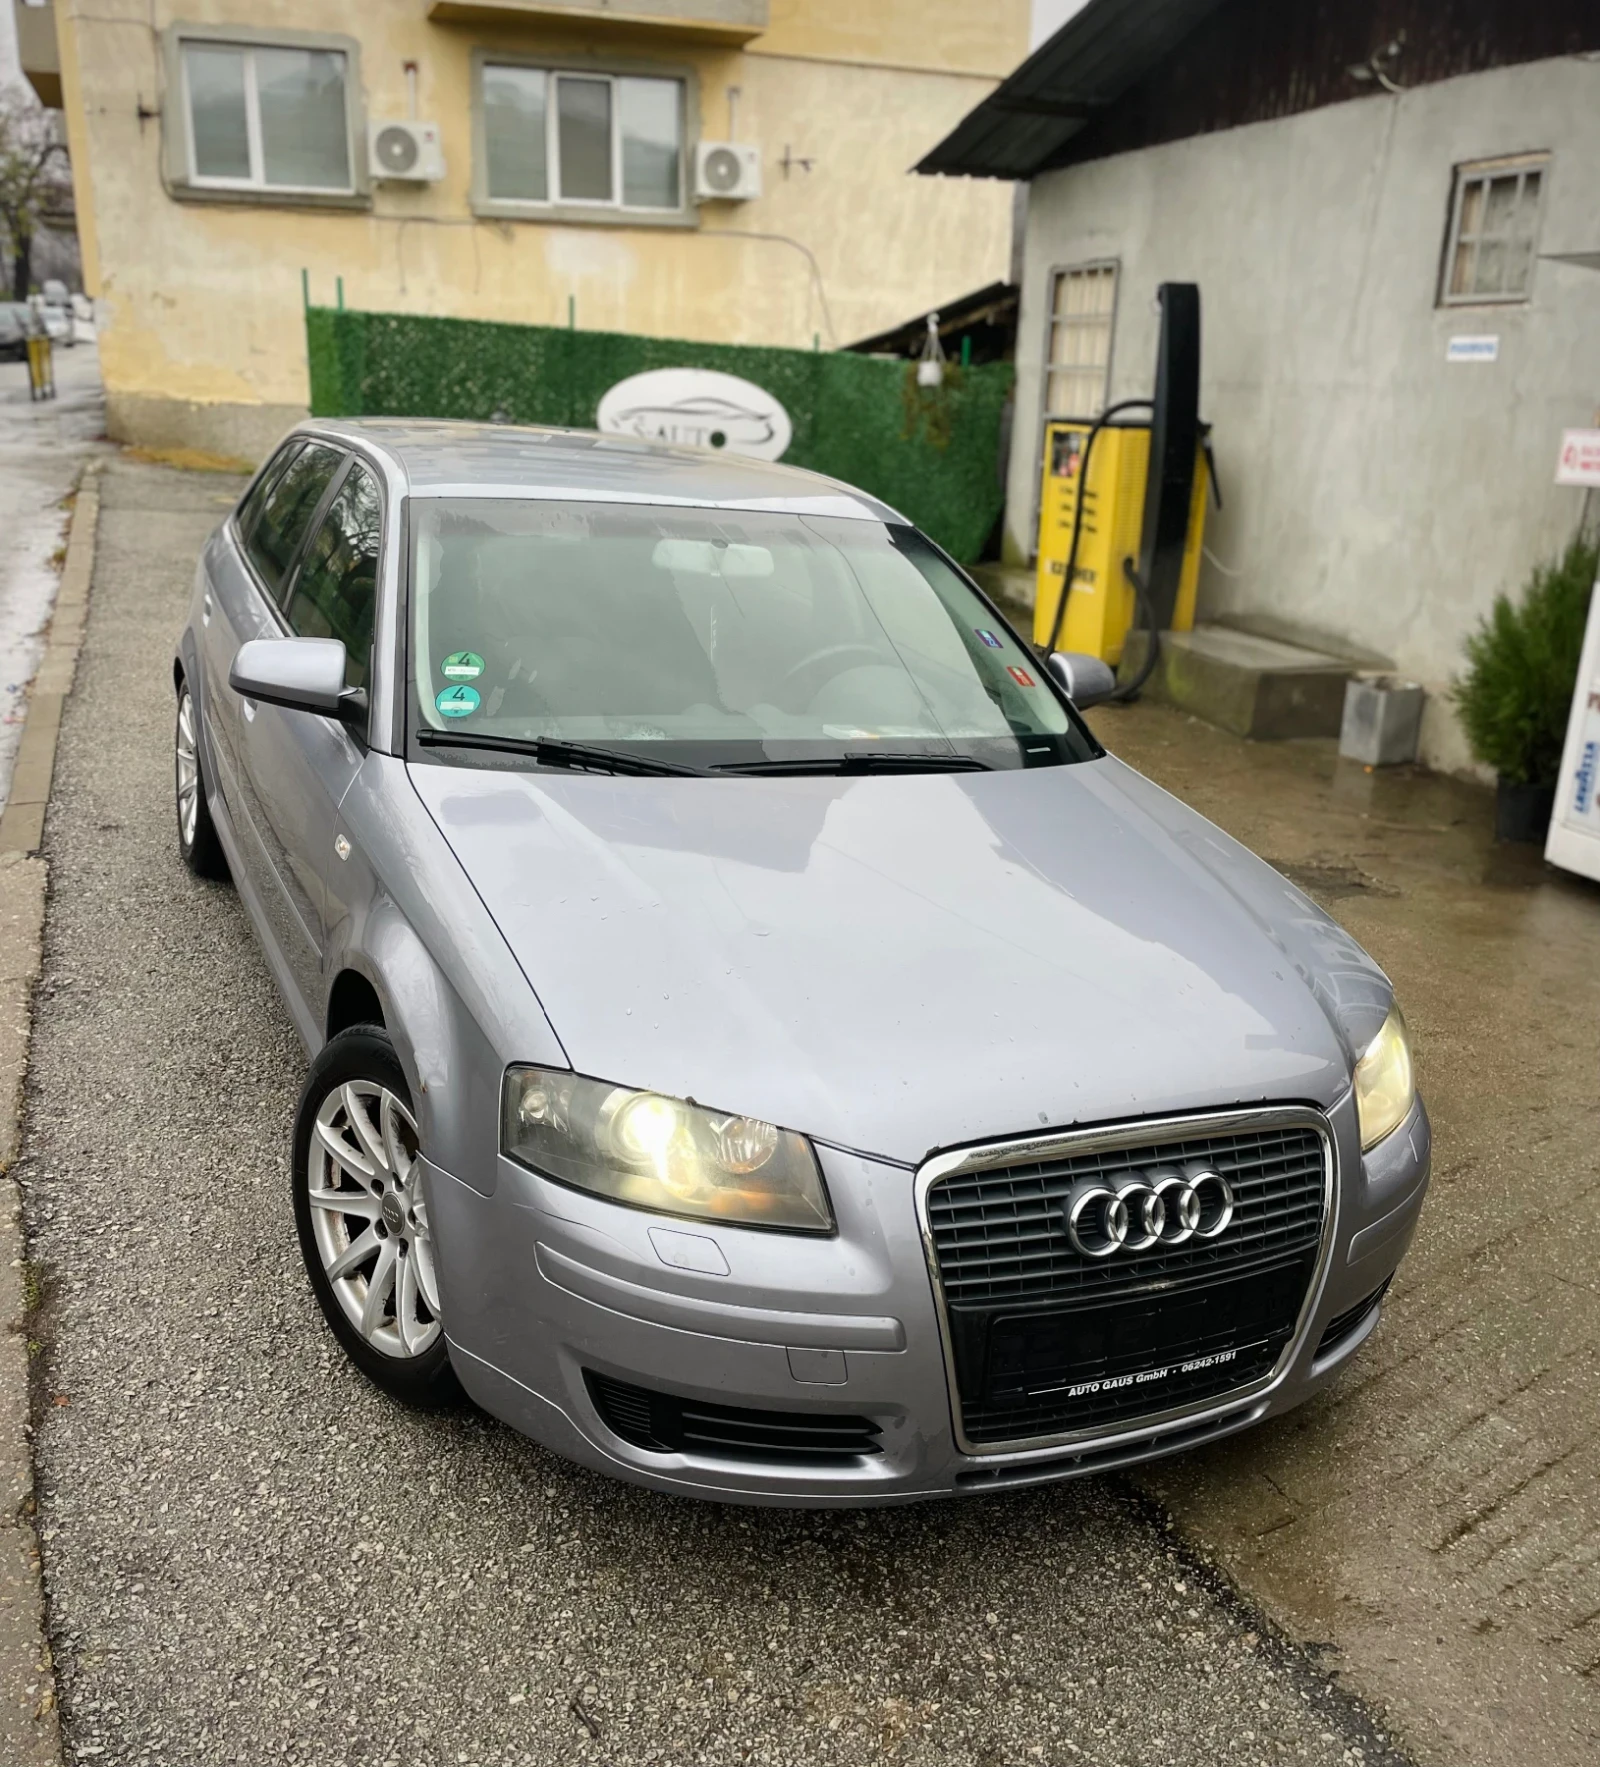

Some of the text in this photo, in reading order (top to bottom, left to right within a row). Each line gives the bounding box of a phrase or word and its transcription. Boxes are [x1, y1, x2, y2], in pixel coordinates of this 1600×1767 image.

[458, 652, 470, 666] 4
[452, 686, 465, 701] 4
[1068, 1351, 1237, 1397] AUTO GAUS GmbH 06242-1591
